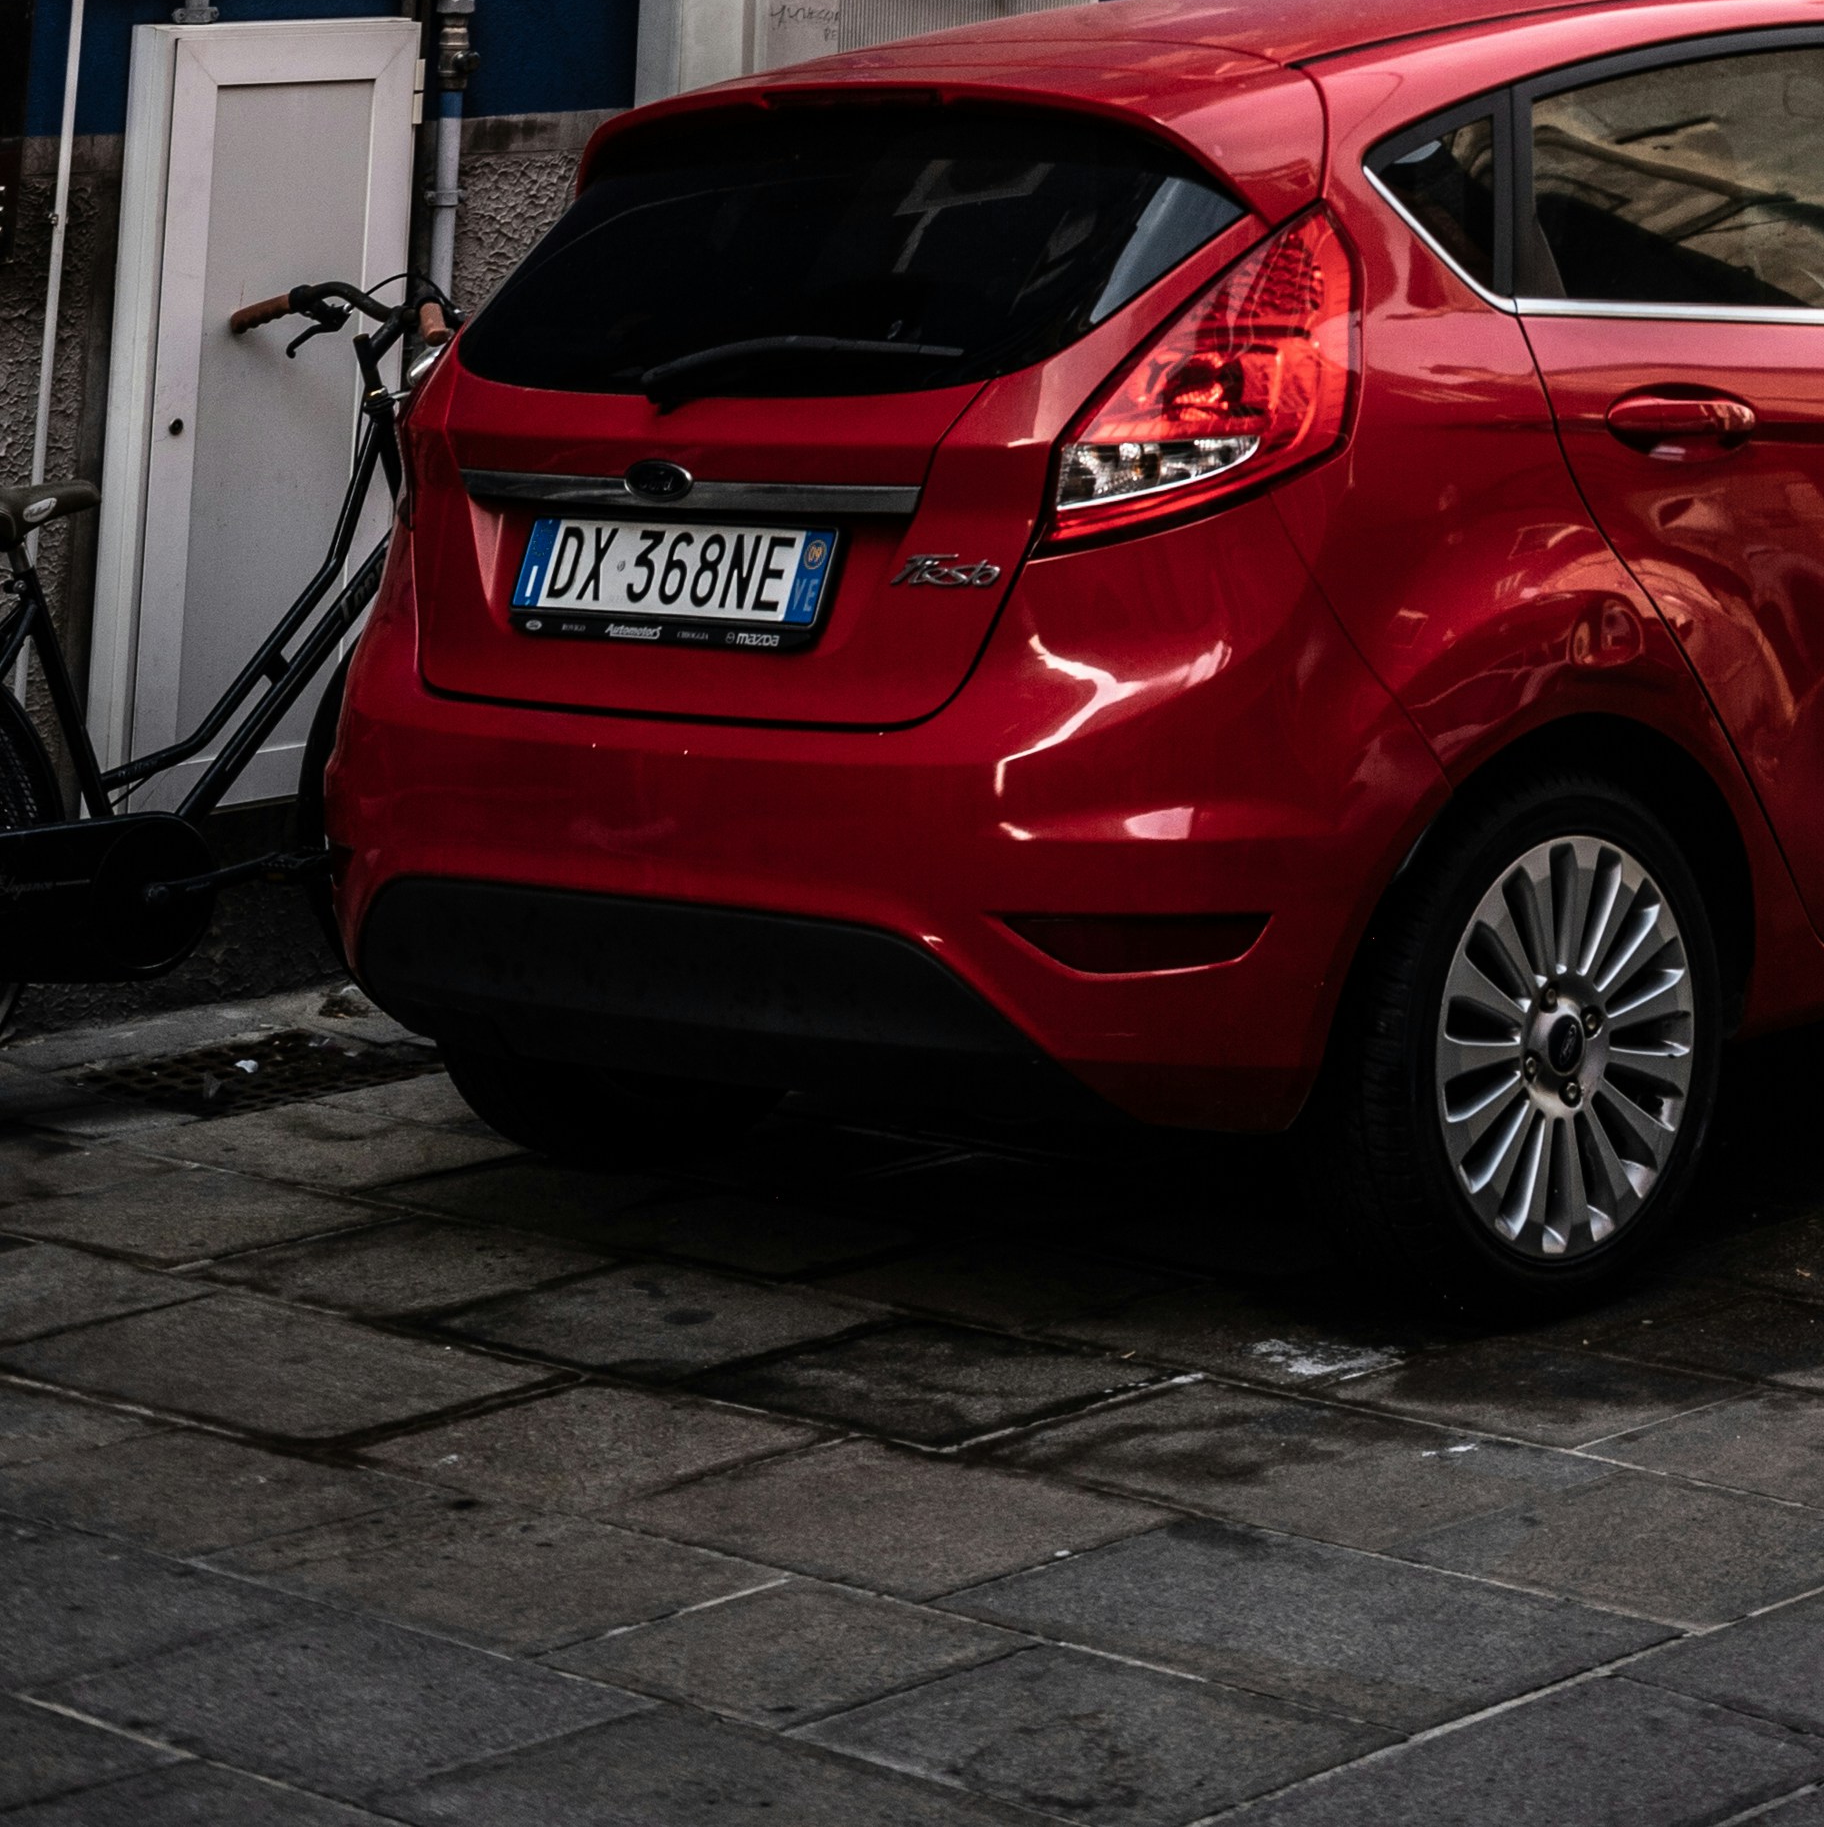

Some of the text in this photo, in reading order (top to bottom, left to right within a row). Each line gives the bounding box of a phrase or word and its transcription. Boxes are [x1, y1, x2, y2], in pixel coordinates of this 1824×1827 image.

[546, 526, 797, 612] DX 368NE
[890, 553, 1001, 586] Fiesta
[792, 578, 820, 612] VE
